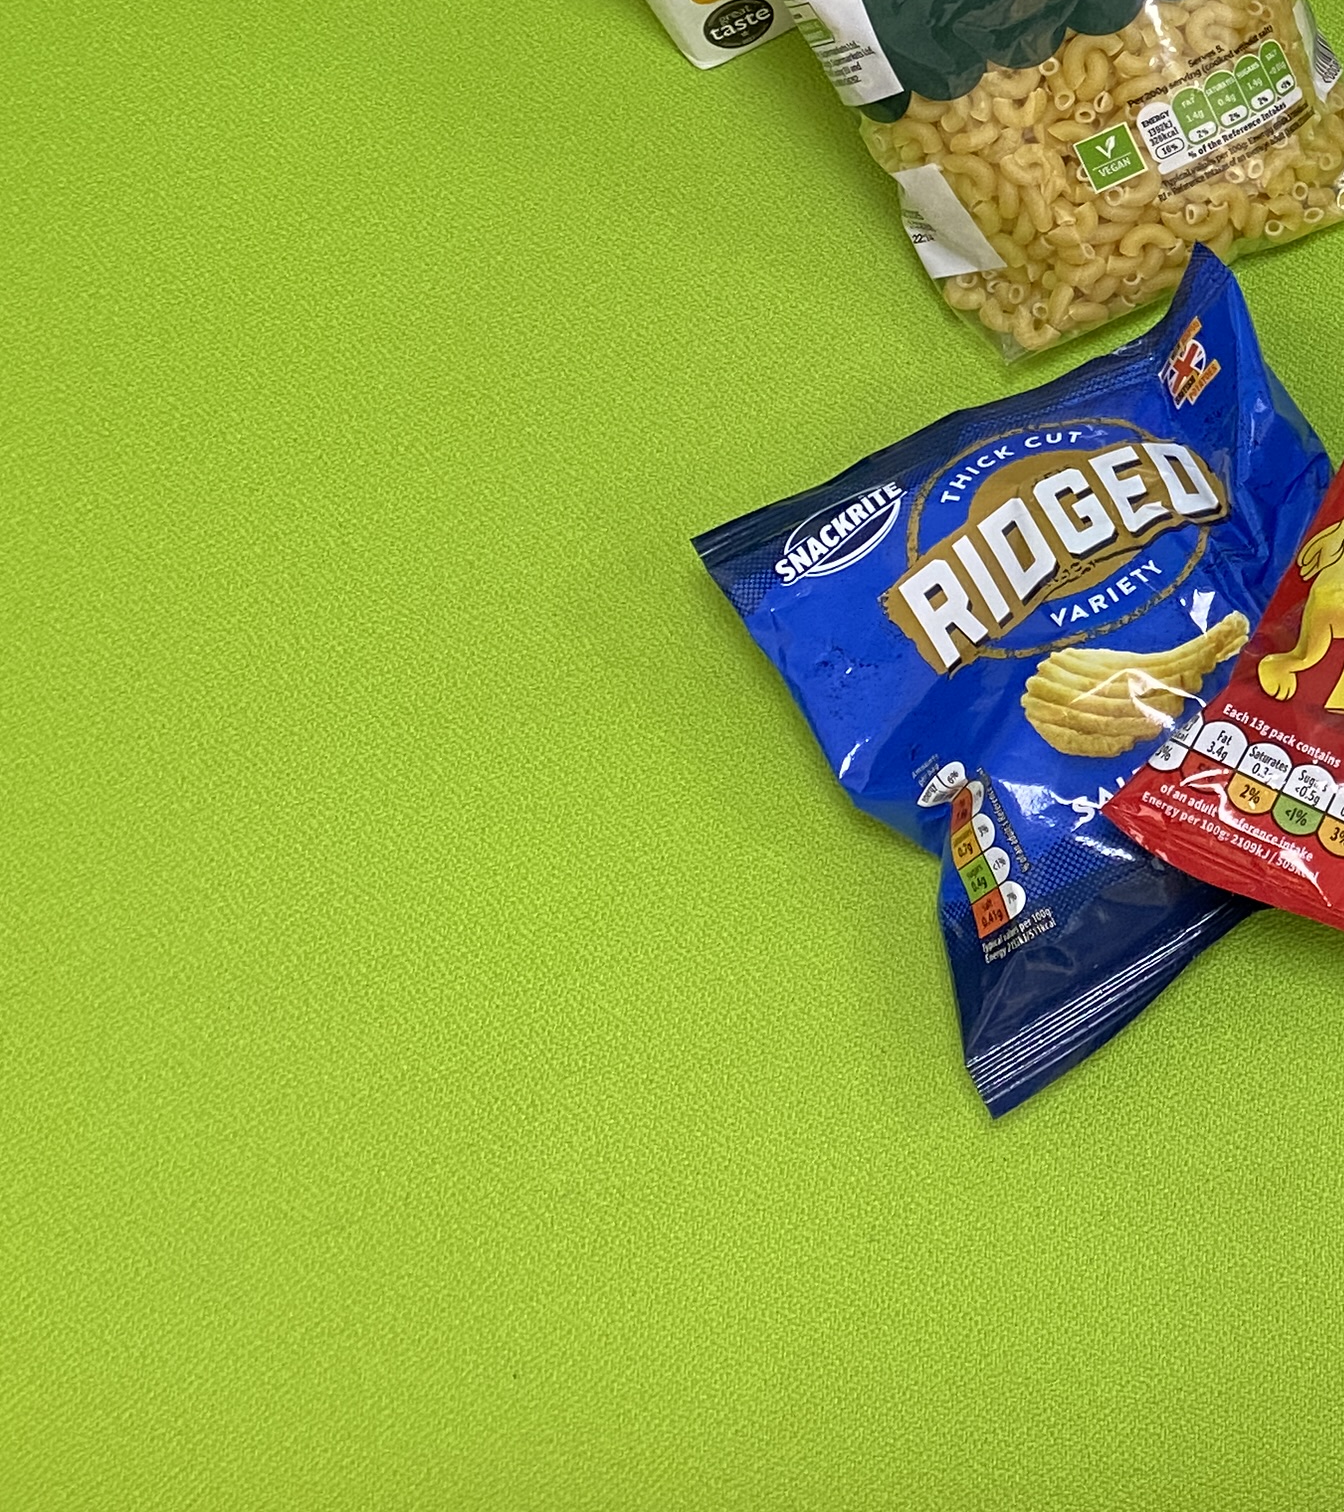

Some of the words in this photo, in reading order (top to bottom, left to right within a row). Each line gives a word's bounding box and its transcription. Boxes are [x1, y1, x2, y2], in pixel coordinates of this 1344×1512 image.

[709, 6, 771, 41] taste
[1098, 157, 1131, 177] VEGAN
[941, 446, 1016, 505] THICK
[1024, 429, 1083, 450] CUT
[899, 441, 1220, 669] RIDGED
[1050, 559, 1163, 628] VARIETY
[1222, 702, 1251, 724] Each
[1270, 726, 1297, 750] pack
[1296, 737, 1342, 770] contains
[1239, 784, 1260, 806] 2%
